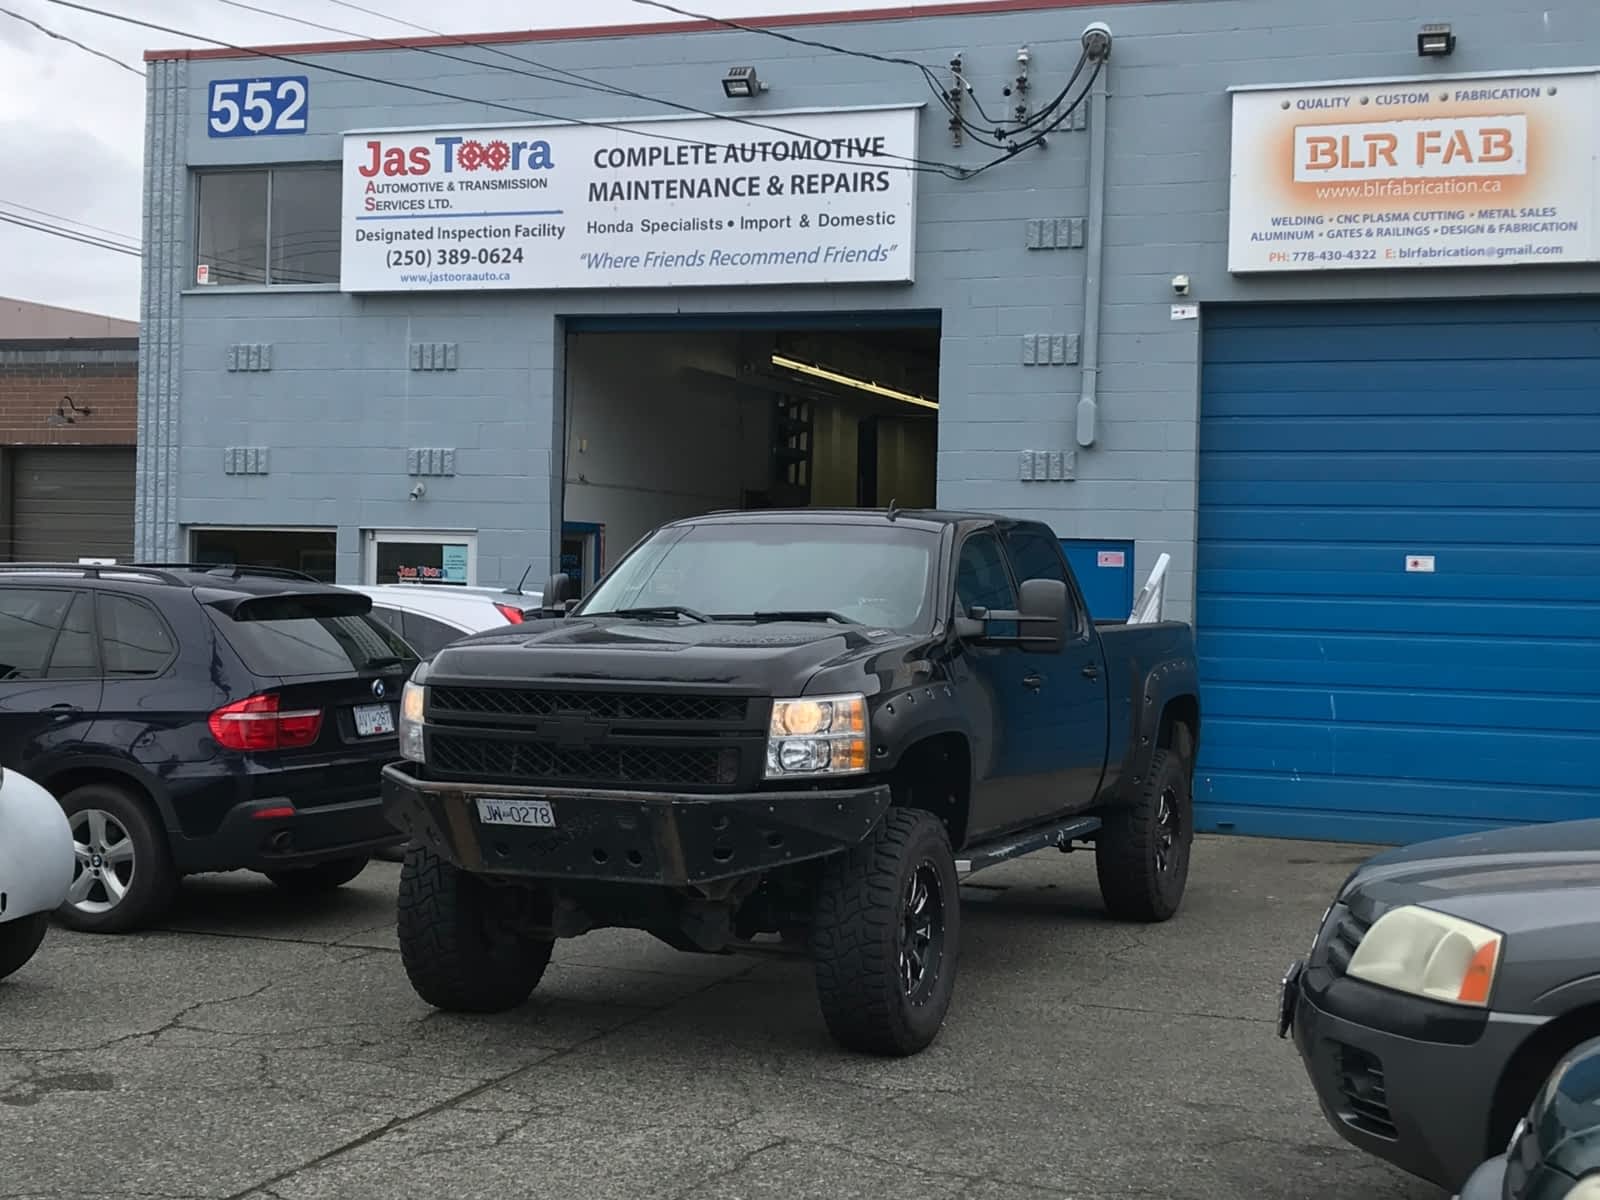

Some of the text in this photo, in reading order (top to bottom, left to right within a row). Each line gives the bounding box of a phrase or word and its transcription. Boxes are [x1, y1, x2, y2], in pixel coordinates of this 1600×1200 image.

[1296, 97, 1351, 110] QUALITY
[1375, 93, 1430, 105] CUSTOM
[1455, 87, 1541, 102] FABRICATION
[210, 80, 305, 133] 552
[358, 136, 555, 177] Jas Toora
[594, 137, 885, 168] COMPLETE AUTOMOTIVE
[1305, 127, 1514, 170] BLR FAB
[365, 178, 548, 194] AUTOMOTIVE & TRANSMISSION
[588, 171, 890, 202] MAINTENANCE & REPAIRS
[1316, 179, 1501, 200] www.blrfabrication.ca
[365, 197, 453, 211] SERVICES LTD.
[587, 211, 896, 234] Honda Specialists Import & Domestic
[1271, 207, 1556, 227] WELDING CNC PLASMA CUTTING METAL SALES
[355, 224, 565, 244] Designated Inspection Facility
[1250, 221, 1578, 241] ALUMINUM GATES & RAILINGS DESIGN & FABRICATION
[386, 247, 524, 268] (250) 389-0624
[643, 250, 704, 268] Friends
[709, 247, 820, 266] Recommend
[1269, 251, 1289, 262] PH:
[1292, 249, 1376, 262] 778-430-4322
[1399, 245, 1563, 260] blrfabrication@gmail.com
[400, 272, 510, 284] www.jastooraauto.ca
[510, 806, 551, 824] 0278
